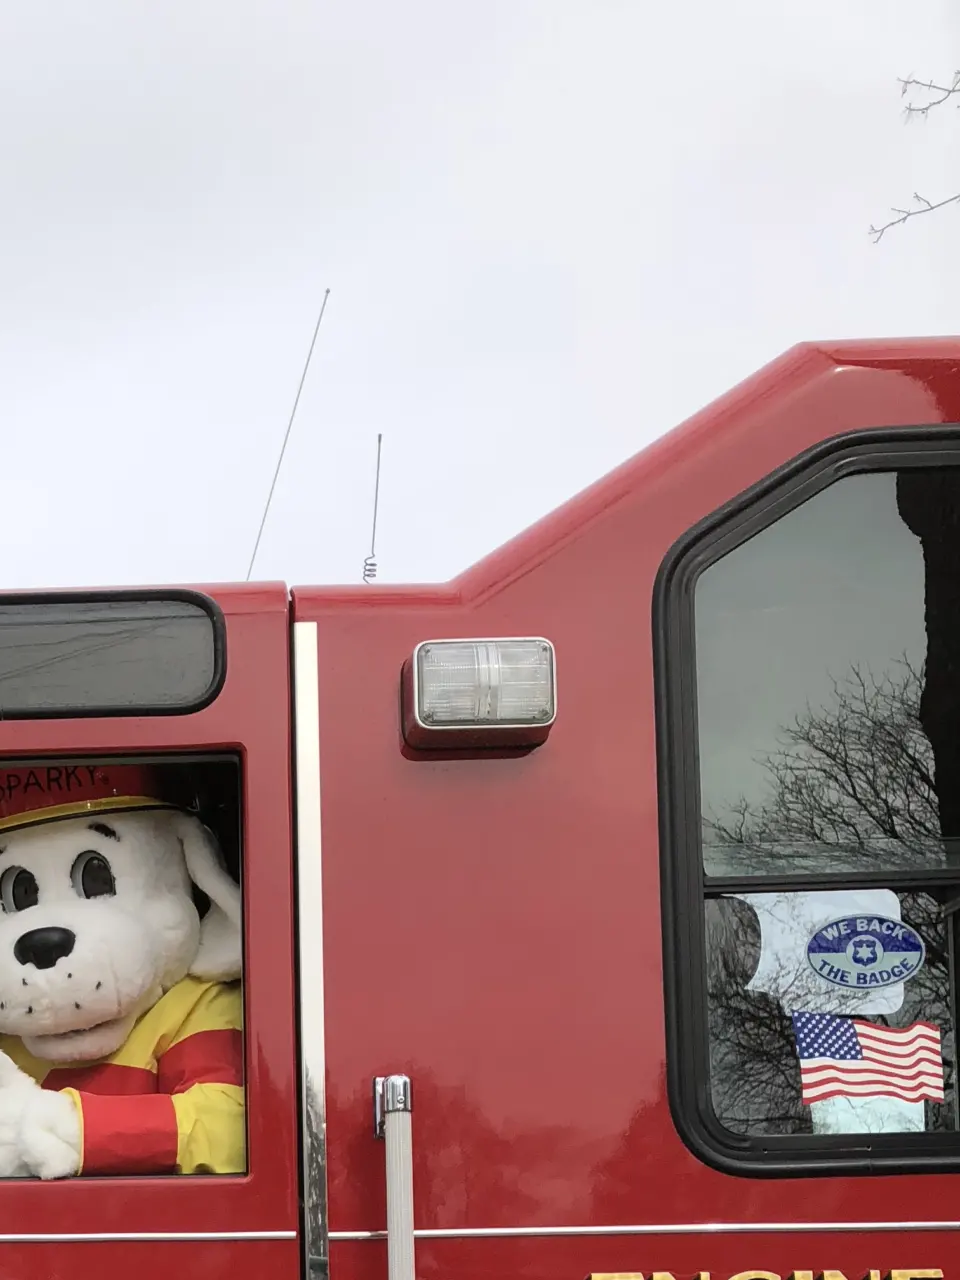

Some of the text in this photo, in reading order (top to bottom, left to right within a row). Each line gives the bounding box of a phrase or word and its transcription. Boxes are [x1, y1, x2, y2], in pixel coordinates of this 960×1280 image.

[821, 919, 908, 941] WE BACK
[819, 958, 915, 985] THE BADGE
